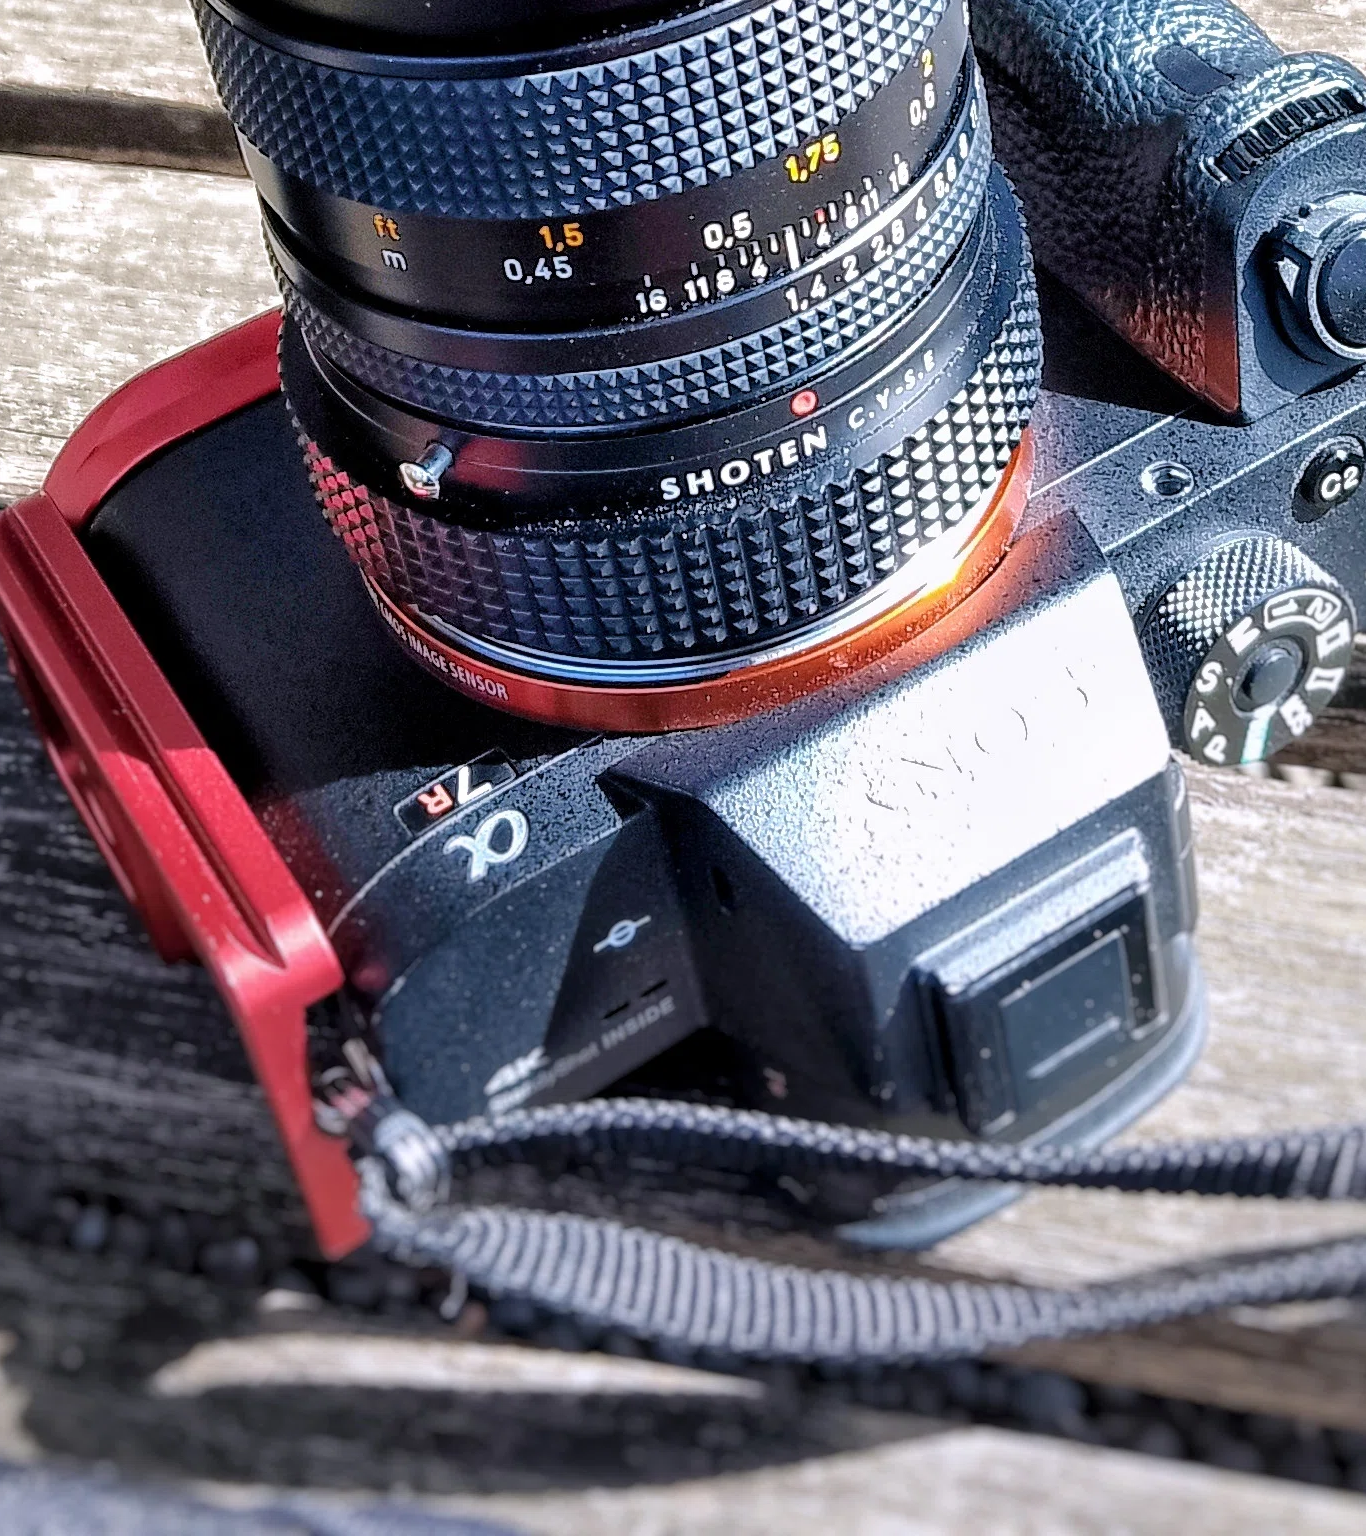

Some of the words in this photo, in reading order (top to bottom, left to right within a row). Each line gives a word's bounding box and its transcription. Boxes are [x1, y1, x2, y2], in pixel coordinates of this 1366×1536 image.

[373, 214, 401, 242] ft
[382, 250, 407, 271] m
[503, 255, 573, 285] 0,45
[636, 288, 668, 313] 16
[685, 276, 710, 302] 11
[716, 268, 735, 293] 8
[751, 254, 769, 279] 4
[815, 222, 832, 248] 4
[841, 254, 860, 282] 2
[660, 425, 830, 501] SHOTEN
[1320, 464, 1360, 501] C2
[1271, 598, 1299, 618] 1
[1306, 596, 1334, 623] 2
[1225, 616, 1261, 657] M
[407, 631, 449, 673] IMAGE
[449, 660, 510, 702] SENSOR
[1195, 661, 1223, 694] S
[1191, 707, 1217, 740] A
[1203, 734, 1228, 764] P
[600, 994, 677, 1051] INSIDE
